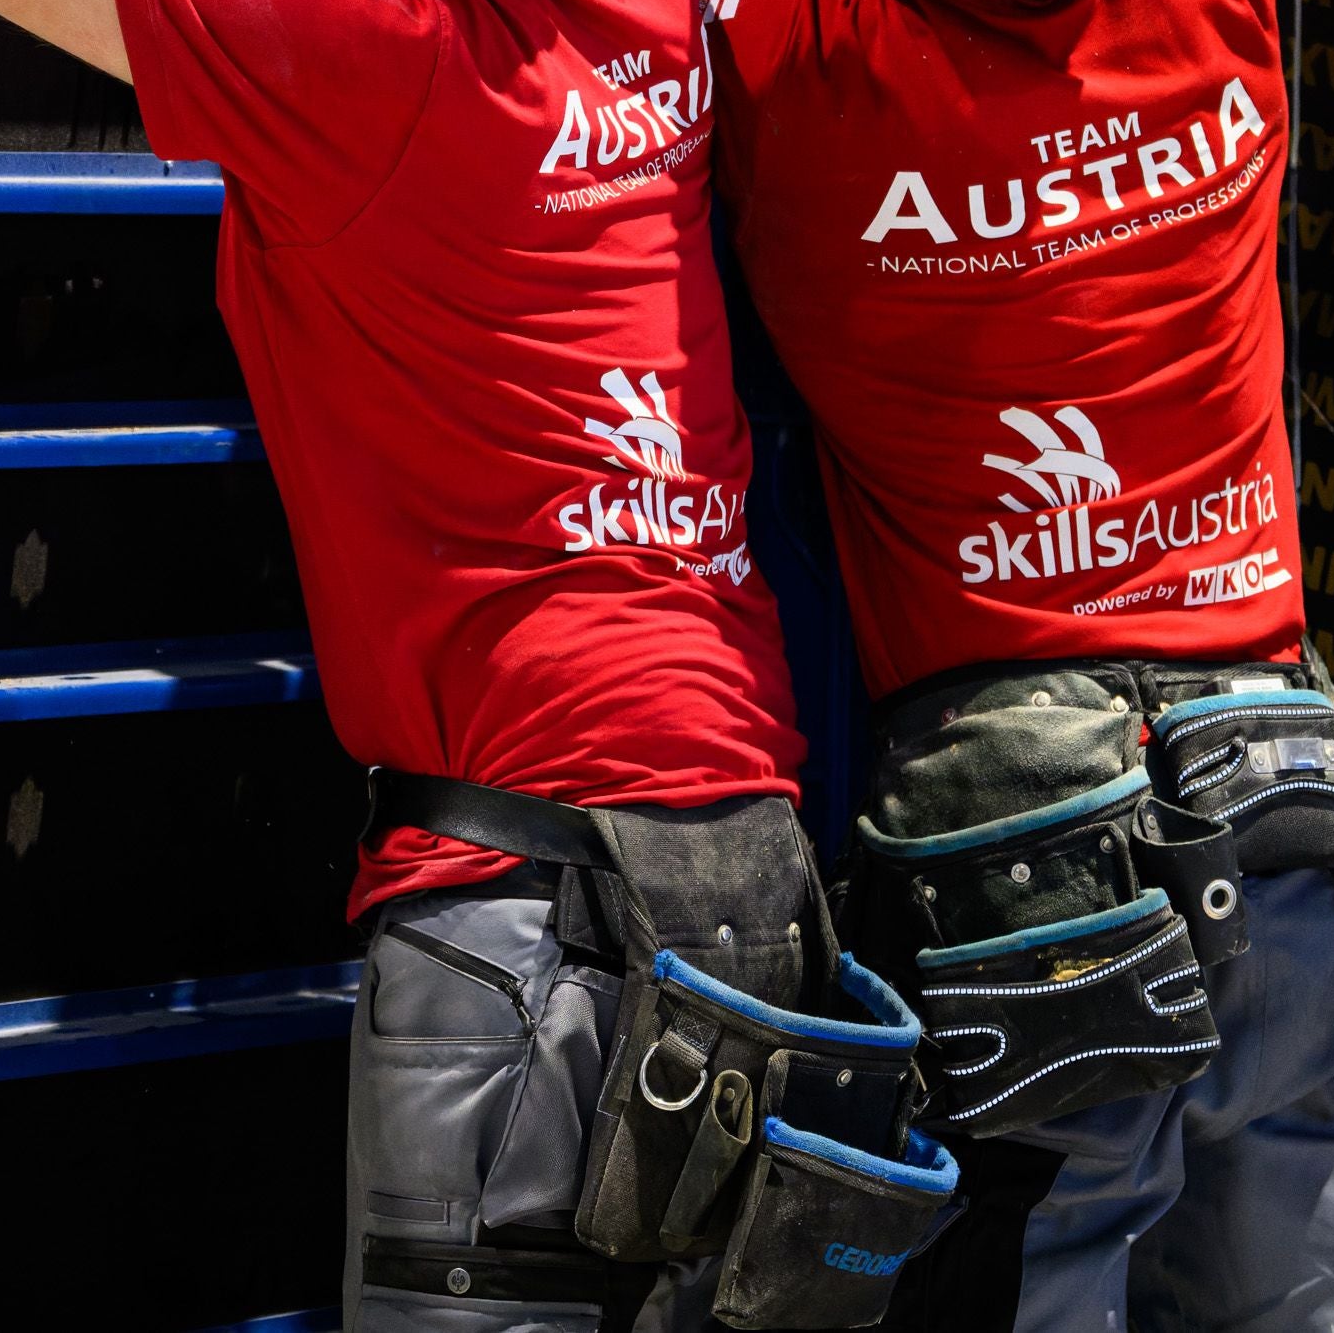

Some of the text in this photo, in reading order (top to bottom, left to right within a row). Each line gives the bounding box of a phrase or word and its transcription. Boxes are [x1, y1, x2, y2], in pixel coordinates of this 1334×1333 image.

[861, 76, 1266, 245] AUSTRIA
[1031, 111, 1142, 165] TEAM
[544, 182, 621, 214] NATIONAL
[613, 170, 650, 191] TEAM
[646, 157, 662, 181] OF
[882, 250, 1027, 276] NATIONAL
[1032, 232, 1106, 261] TEAM
[1112, 219, 1143, 240] OF
[1148, 150, 1264, 229] PROFESSIONS
[1073, 561, 1260, 616] powered by WKO
